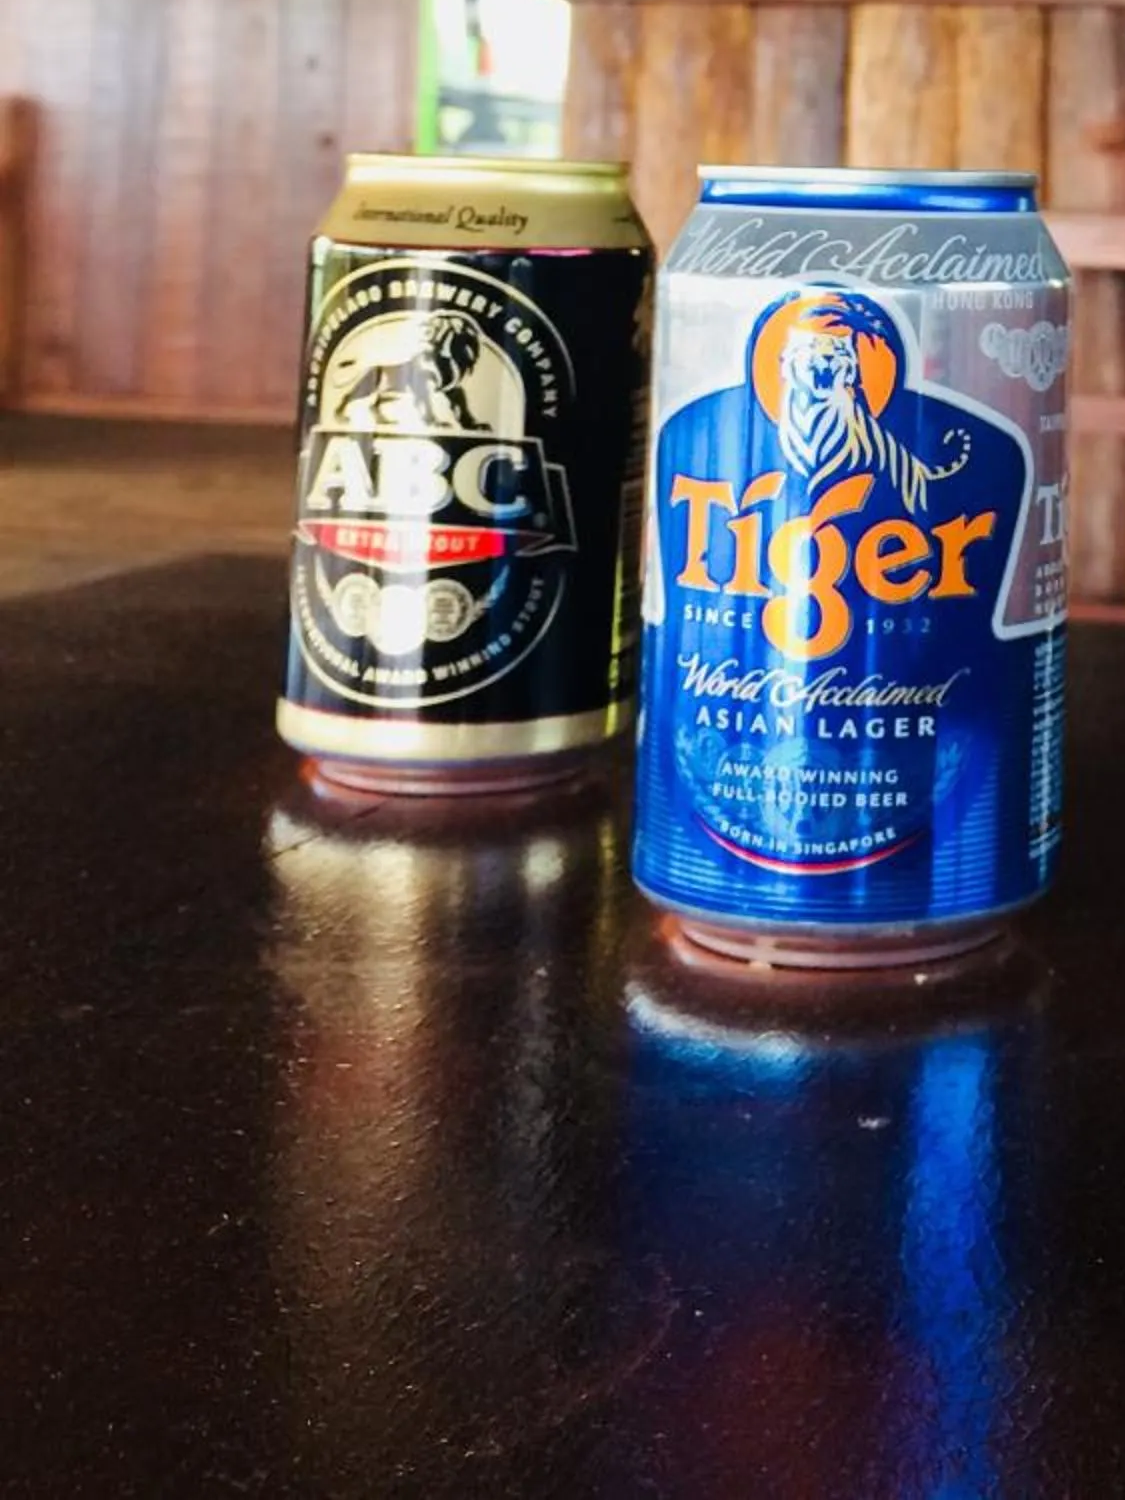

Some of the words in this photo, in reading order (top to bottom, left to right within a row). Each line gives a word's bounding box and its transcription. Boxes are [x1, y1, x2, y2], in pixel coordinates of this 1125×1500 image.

[455, 205, 528, 235] Quality
[673, 214, 828, 276] World
[801, 223, 1045, 283] Acclaimed
[388, 279, 503, 319] BREWERY
[504, 316, 559, 418] COMPANY
[306, 434, 532, 519] ABC
[669, 472, 997, 661] Tiger
[684, 604, 753, 629] SINCE
[866, 616, 931, 634] 1932
[432, 635, 512, 680] WINNING
[677, 652, 784, 702] World
[769, 666, 971, 714] Acclaimed
[696, 705, 796, 736] ASIAN
[818, 716, 936, 738] LAGER
[712, 782, 847, 807] FULL-BODIED
[855, 792, 908, 807] BEER
[801, 769, 899, 785] WINNING
[720, 820, 764, 848] BORN
[769, 837, 788, 853] IN
[793, 826, 897, 855] SINGAPORE
